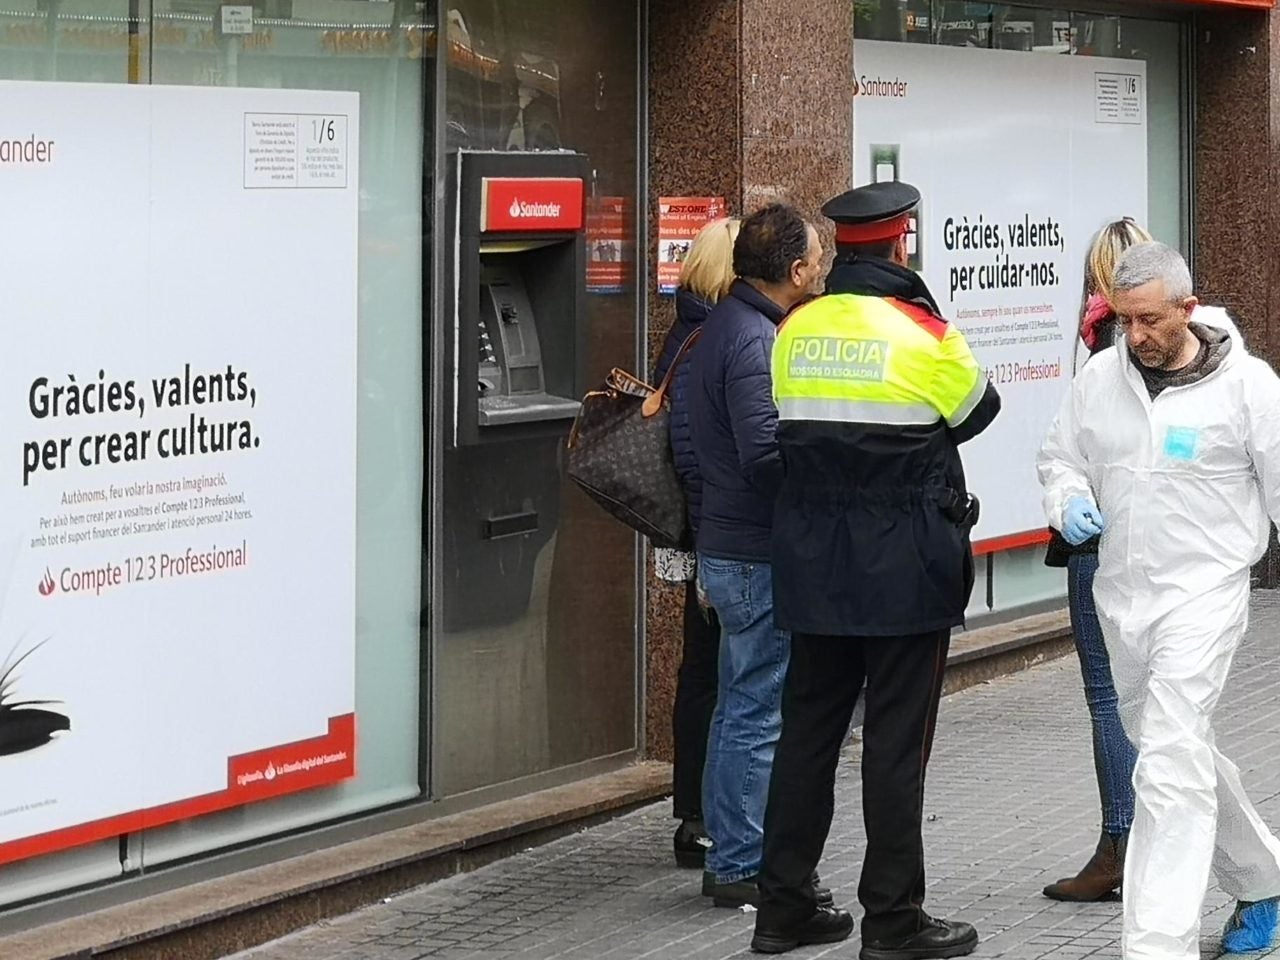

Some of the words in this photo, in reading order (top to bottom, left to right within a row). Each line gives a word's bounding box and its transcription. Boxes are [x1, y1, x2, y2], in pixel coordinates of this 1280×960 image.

[861, 76, 908, 97] Santander
[312, 118, 335, 144] 1/6
[520, 201, 561, 218] Santander
[944, 214, 1004, 255] Gràcies,
[1008, 213, 1064, 253] valents,
[950, 266, 975, 302] per
[978, 254, 1059, 290] cuidar-nos.
[790, 338, 882, 364] POLICIA
[1014, 355, 1062, 382] Professional
[29, 369, 145, 418] Gràcies,
[152, 363, 257, 408] valents,
[23, 436, 72, 486] per
[79, 428, 151, 467] crear
[157, 414, 260, 458] cultura.
[61, 488, 108, 505] Autònoms,
[109, 485, 124, 500] feu
[125, 481, 145, 497] volar
[155, 479, 181, 493] nostra
[39, 516, 52, 529] Per
[69, 513, 85, 526] hem
[86, 510, 104, 523] creat
[105, 509, 117, 524] per
[161, 500, 188, 517] Compte
[47, 532, 59, 546] tot
[67, 528, 91, 545] suport
[121, 521, 133, 536] del
[60, 562, 122, 596] Compte
[160, 539, 247, 579] Professional
